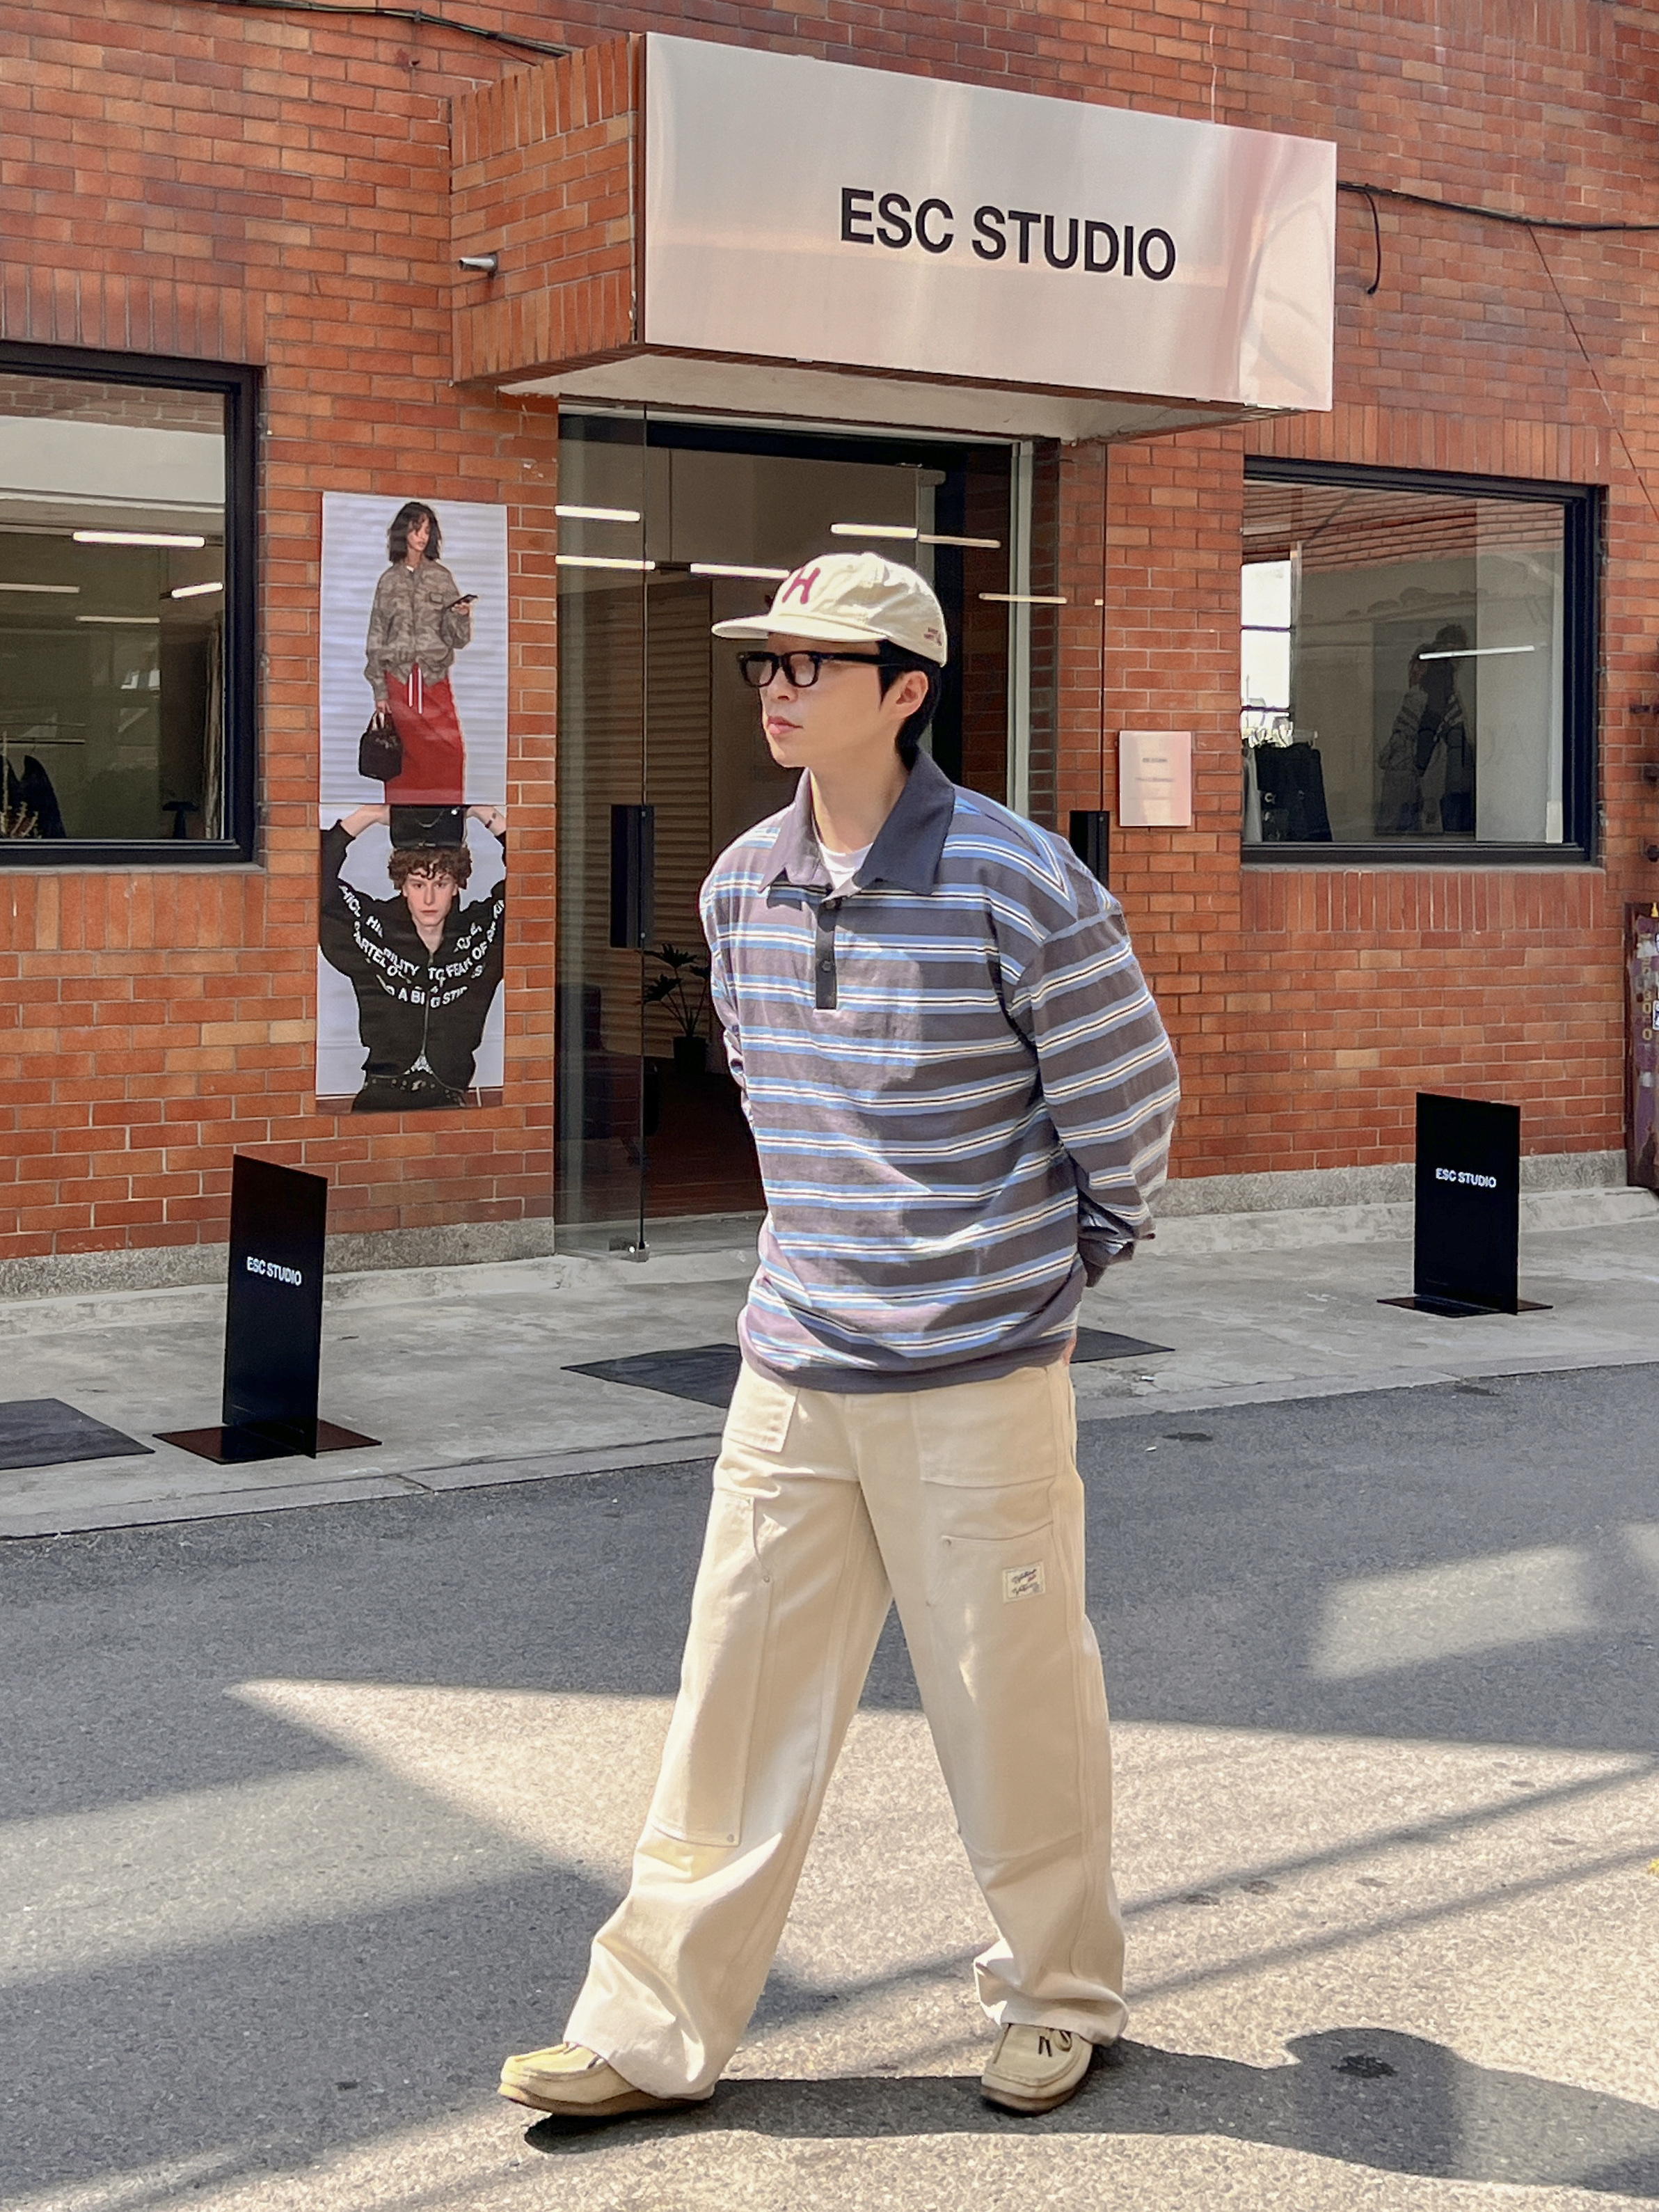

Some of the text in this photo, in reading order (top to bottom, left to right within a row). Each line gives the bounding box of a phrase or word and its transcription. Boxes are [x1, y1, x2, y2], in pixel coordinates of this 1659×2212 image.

[841, 187, 1176, 281] ESC STUDIO
[781, 566, 820, 605] H
[1436, 1168, 1496, 1188] ESC STUDIO
[247, 1256, 301, 1286] ESC STUDIO
